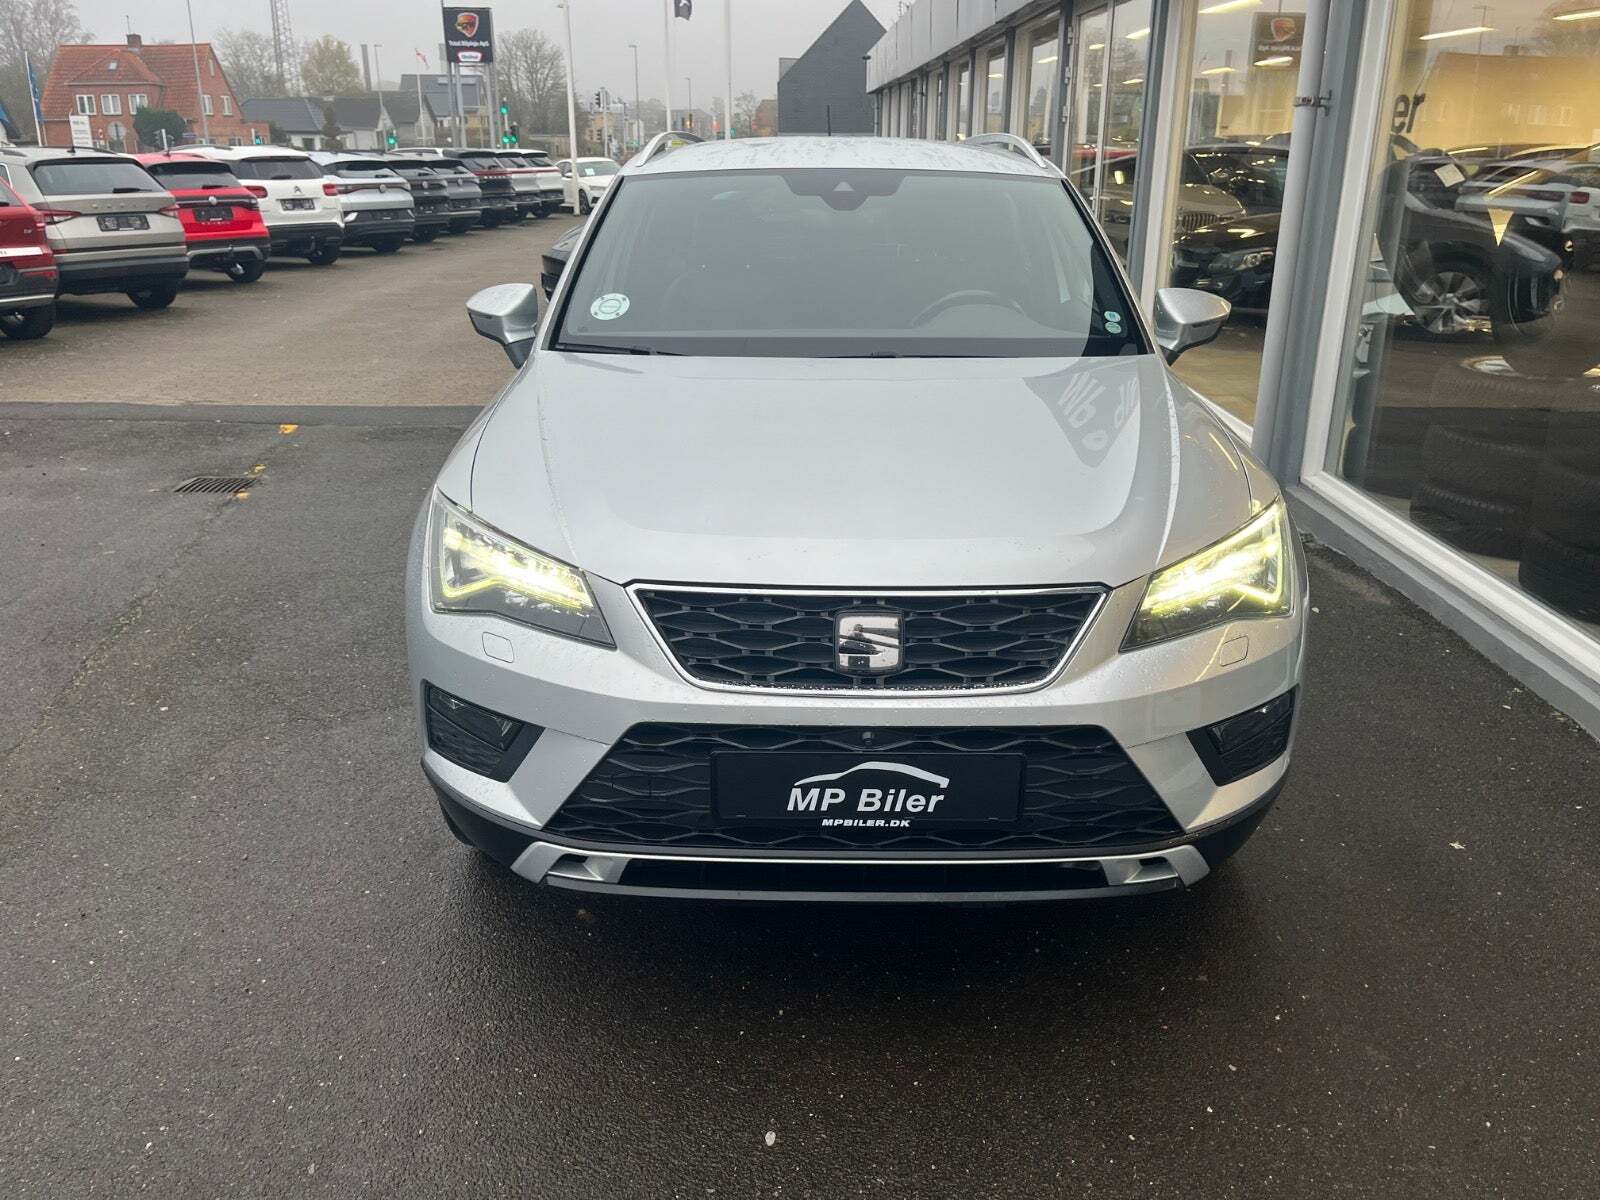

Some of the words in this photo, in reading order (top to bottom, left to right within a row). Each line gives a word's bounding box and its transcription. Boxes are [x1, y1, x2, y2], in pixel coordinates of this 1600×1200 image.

[787, 787, 846, 811] MP
[857, 788, 945, 812] Biler
[821, 818, 911, 827] MPBILER.DK
